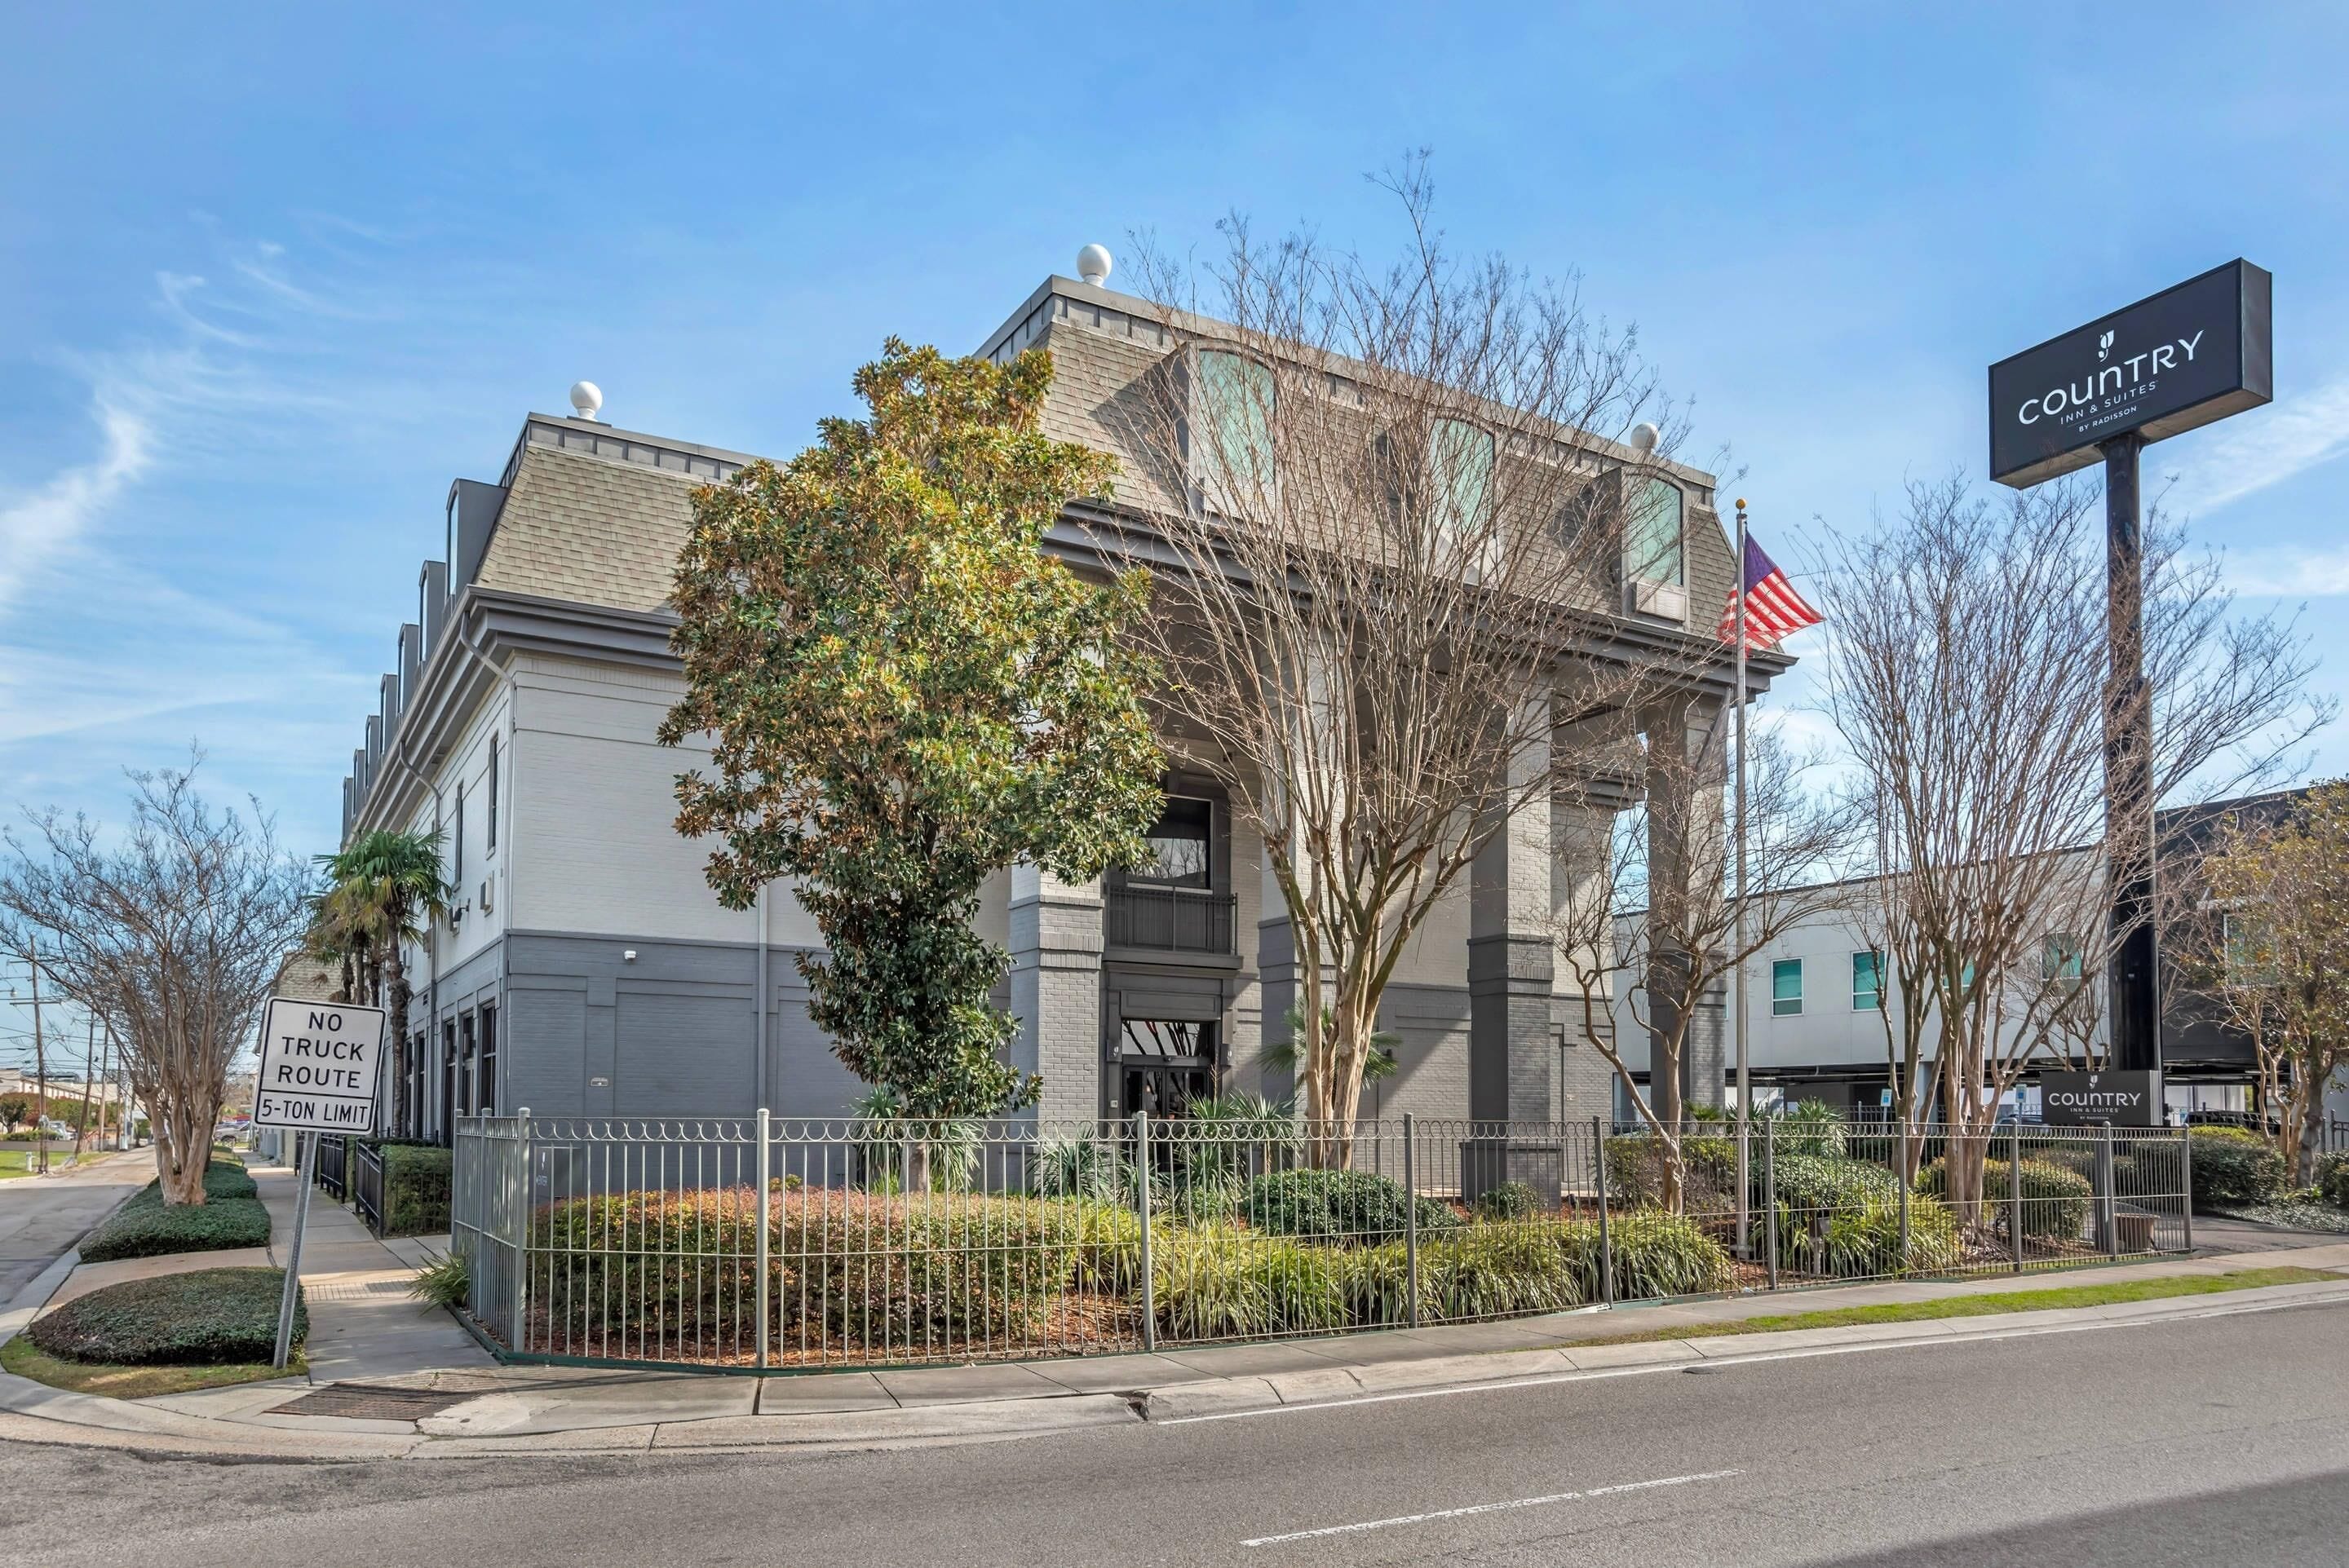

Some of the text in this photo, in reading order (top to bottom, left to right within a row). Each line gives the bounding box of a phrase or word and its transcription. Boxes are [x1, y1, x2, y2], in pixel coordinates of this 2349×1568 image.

[2060, 381, 2157, 425] INN & SUITES
[2078, 405, 2137, 432] BY RADISSON
[308, 1011, 343, 1031] NO
[281, 1036, 365, 1062] TRUCK
[277, 1065, 361, 1089] ROUTE
[262, 1099, 368, 1124] 5-TON LIMIT
